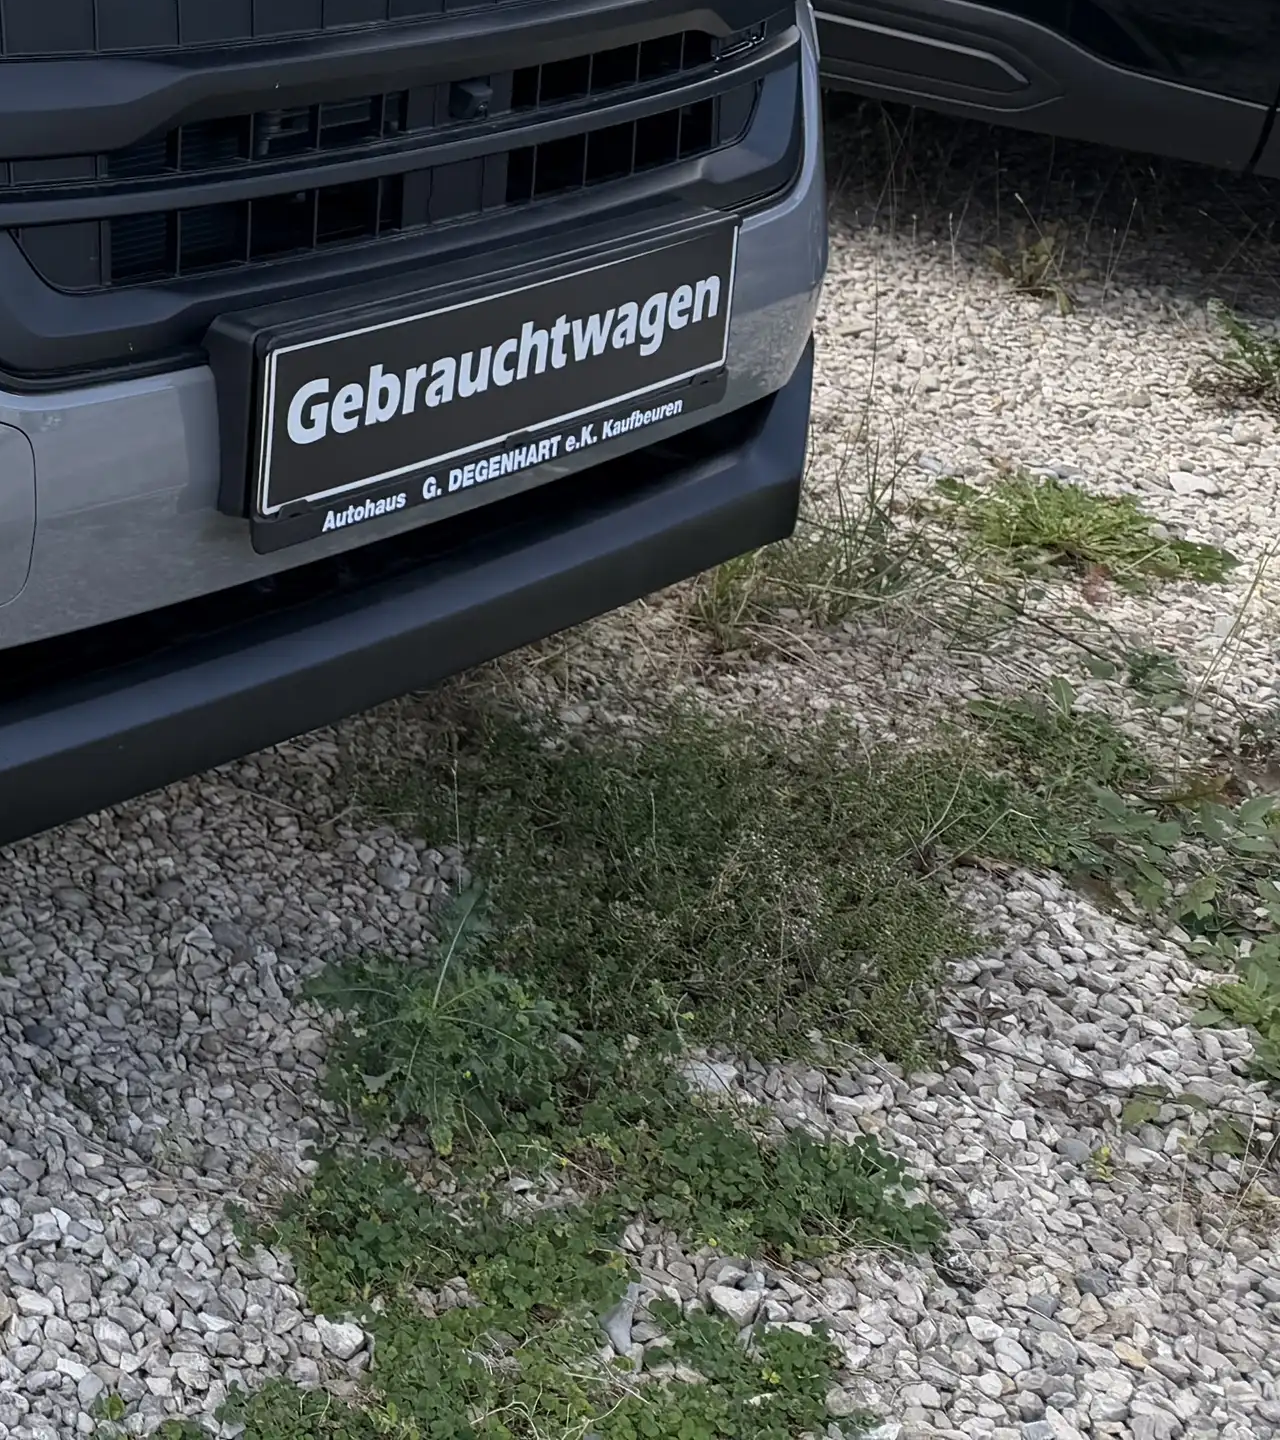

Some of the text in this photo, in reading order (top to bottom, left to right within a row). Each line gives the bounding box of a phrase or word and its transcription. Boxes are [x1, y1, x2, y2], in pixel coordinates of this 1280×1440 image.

[286, 274, 721, 445] Gebrauchtwagen
[322, 398, 683, 532] Autohaus G. DEGENHART e.K. Kaufbeuren
